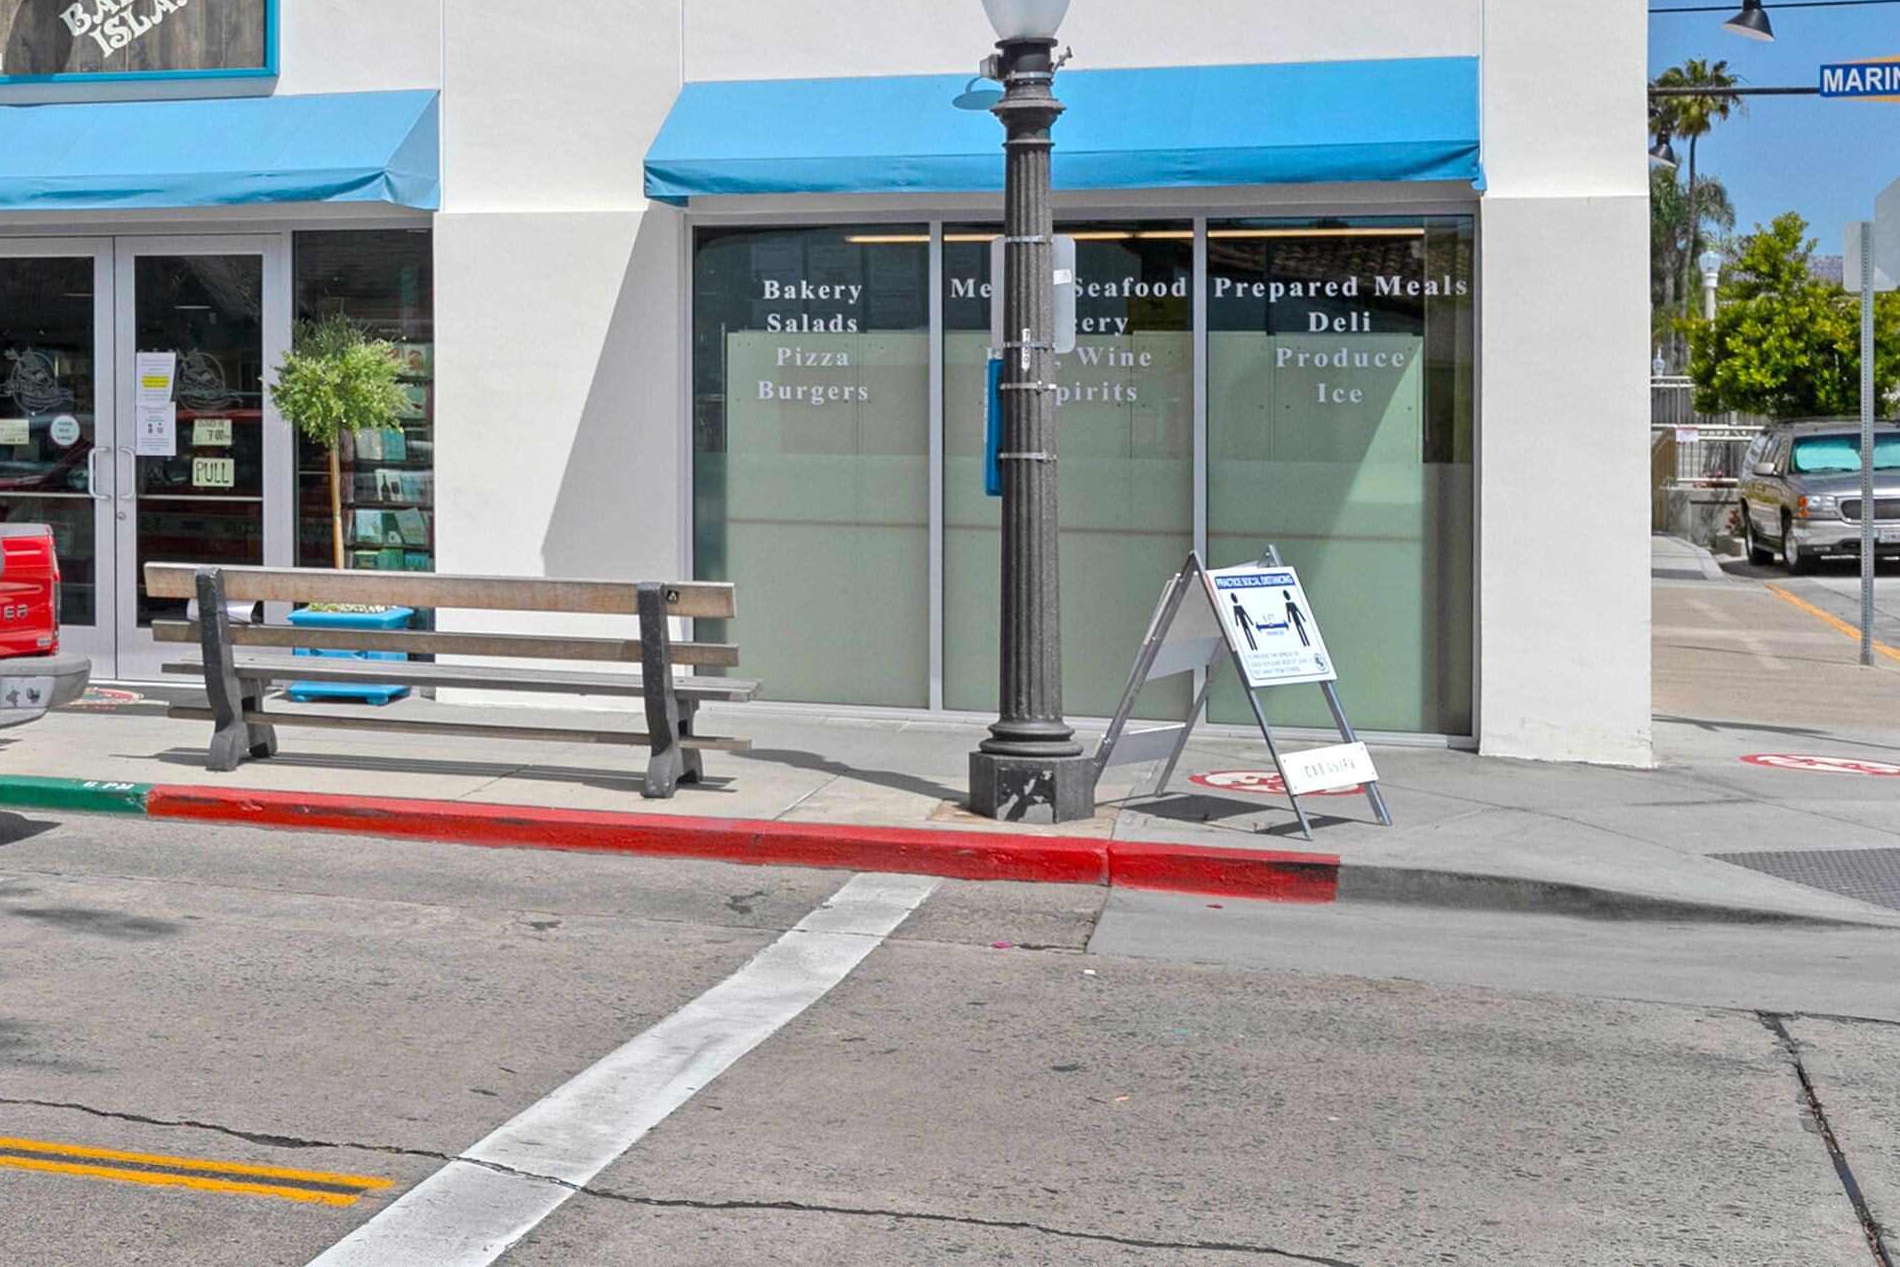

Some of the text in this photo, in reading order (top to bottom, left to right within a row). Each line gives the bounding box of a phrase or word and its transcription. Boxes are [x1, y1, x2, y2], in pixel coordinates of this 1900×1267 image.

[763, 280, 862, 304] Bakery
[1214, 276, 1468, 302] Prepared Meals
[767, 313, 858, 333] Salads
[1308, 311, 1370, 332] Deli
[776, 347, 849, 366] Pizza
[1077, 347, 1153, 367] Wine
[1276, 347, 1405, 368] Produce
[757, 380, 868, 405] Burgers
[1055, 381, 1138, 405] pirits
[1317, 383, 1363, 403] Ice
[196, 461, 229, 484] PULL
